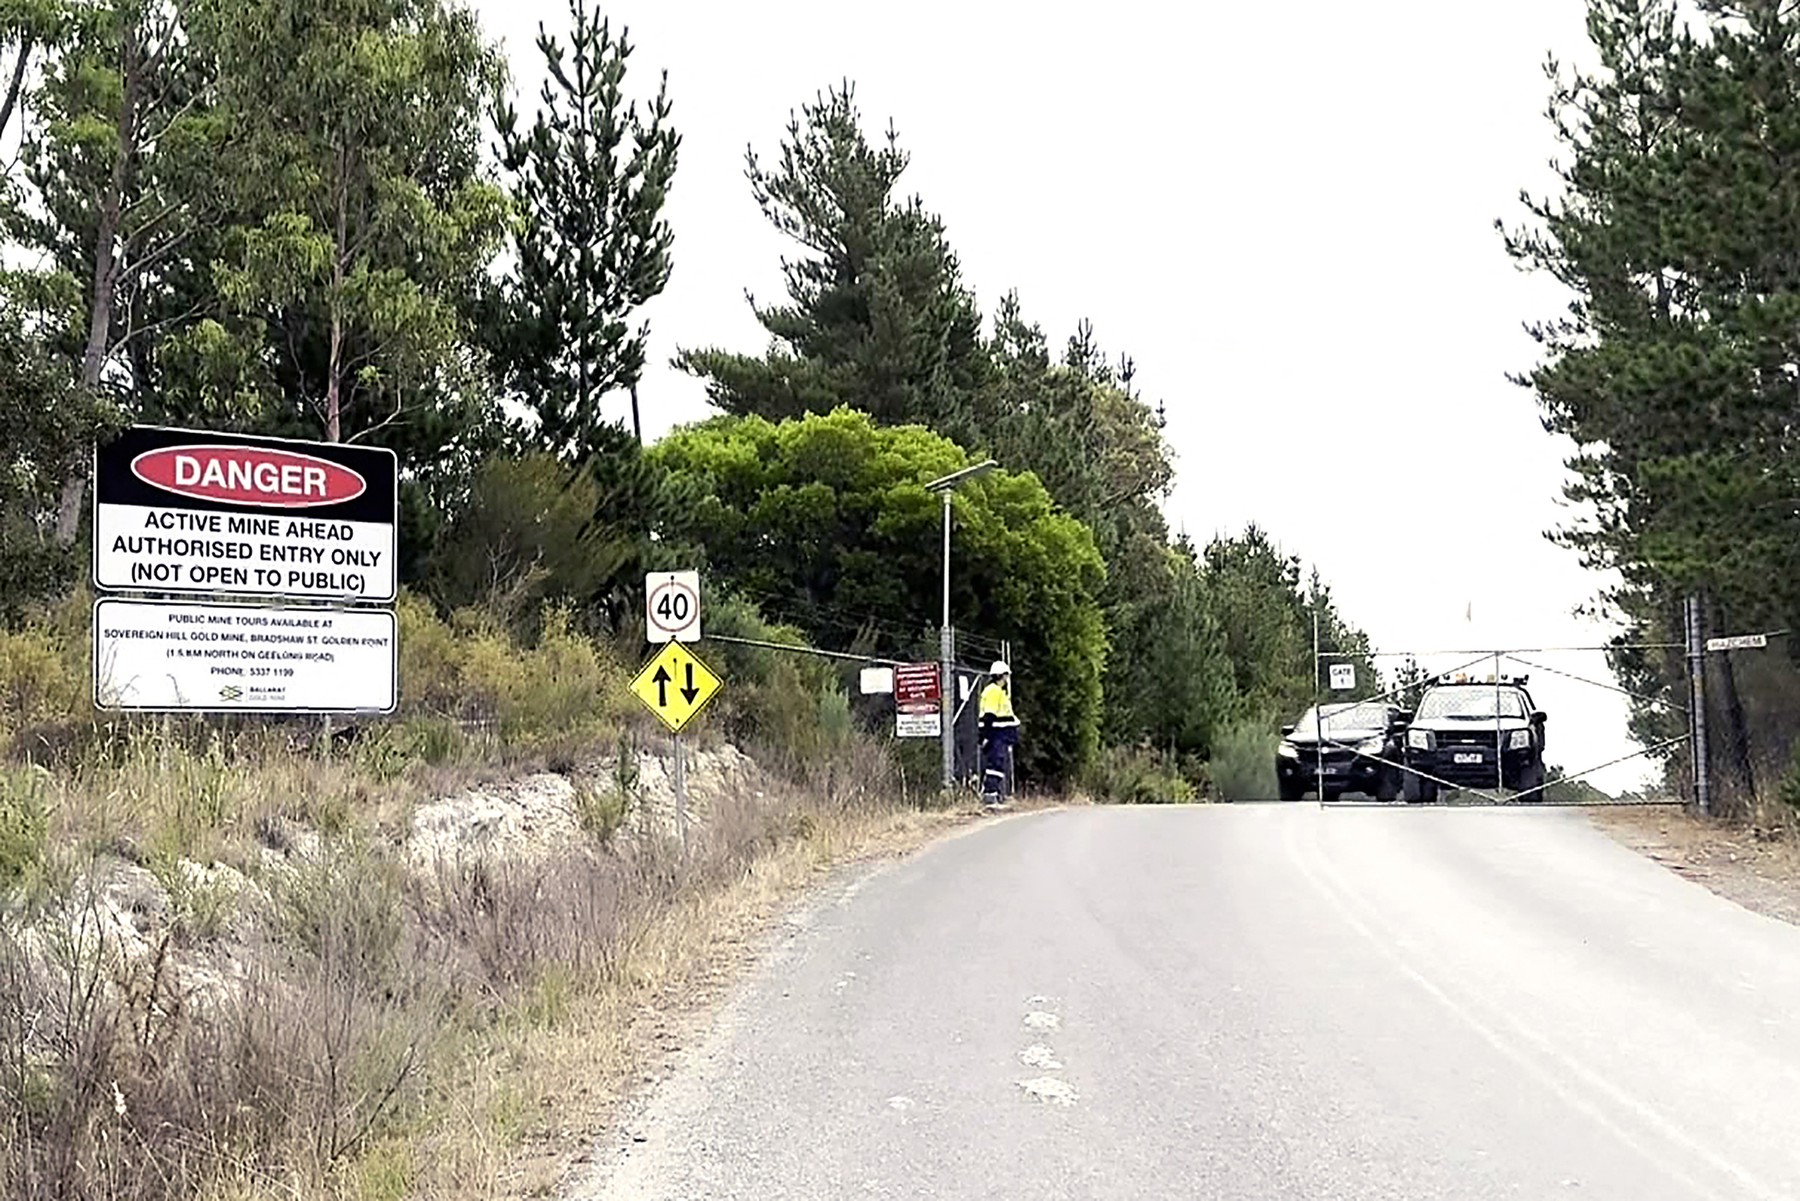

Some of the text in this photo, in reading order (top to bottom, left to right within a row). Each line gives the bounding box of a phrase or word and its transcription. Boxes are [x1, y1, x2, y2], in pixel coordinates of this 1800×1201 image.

[175, 456, 327, 496] DANGER
[145, 511, 353, 541] ACTIVE MINE AHEAD
[112, 536, 381, 568] AUTHORISED ENTRY ONLY
[131, 563, 365, 594] (NOT OPEN TO PUBLIC)
[657, 593, 688, 620] 40
[169, 613, 333, 629] PUBLIC MINE TOURS AVAILABLE AT
[104, 628, 164, 640] SOVEREIGN
[166, 631, 188, 642] HILL
[190, 632, 219, 642] GOLD
[250, 633, 304, 645] BRADSHAW
[321, 636, 360, 647] GOLDEN
[204, 649, 239, 660] NORTH
[241, 650, 256, 660] ON
[257, 650, 303, 661] GEELONG
[249, 667, 271, 677] 5337
[273, 667, 295, 678] 1199
